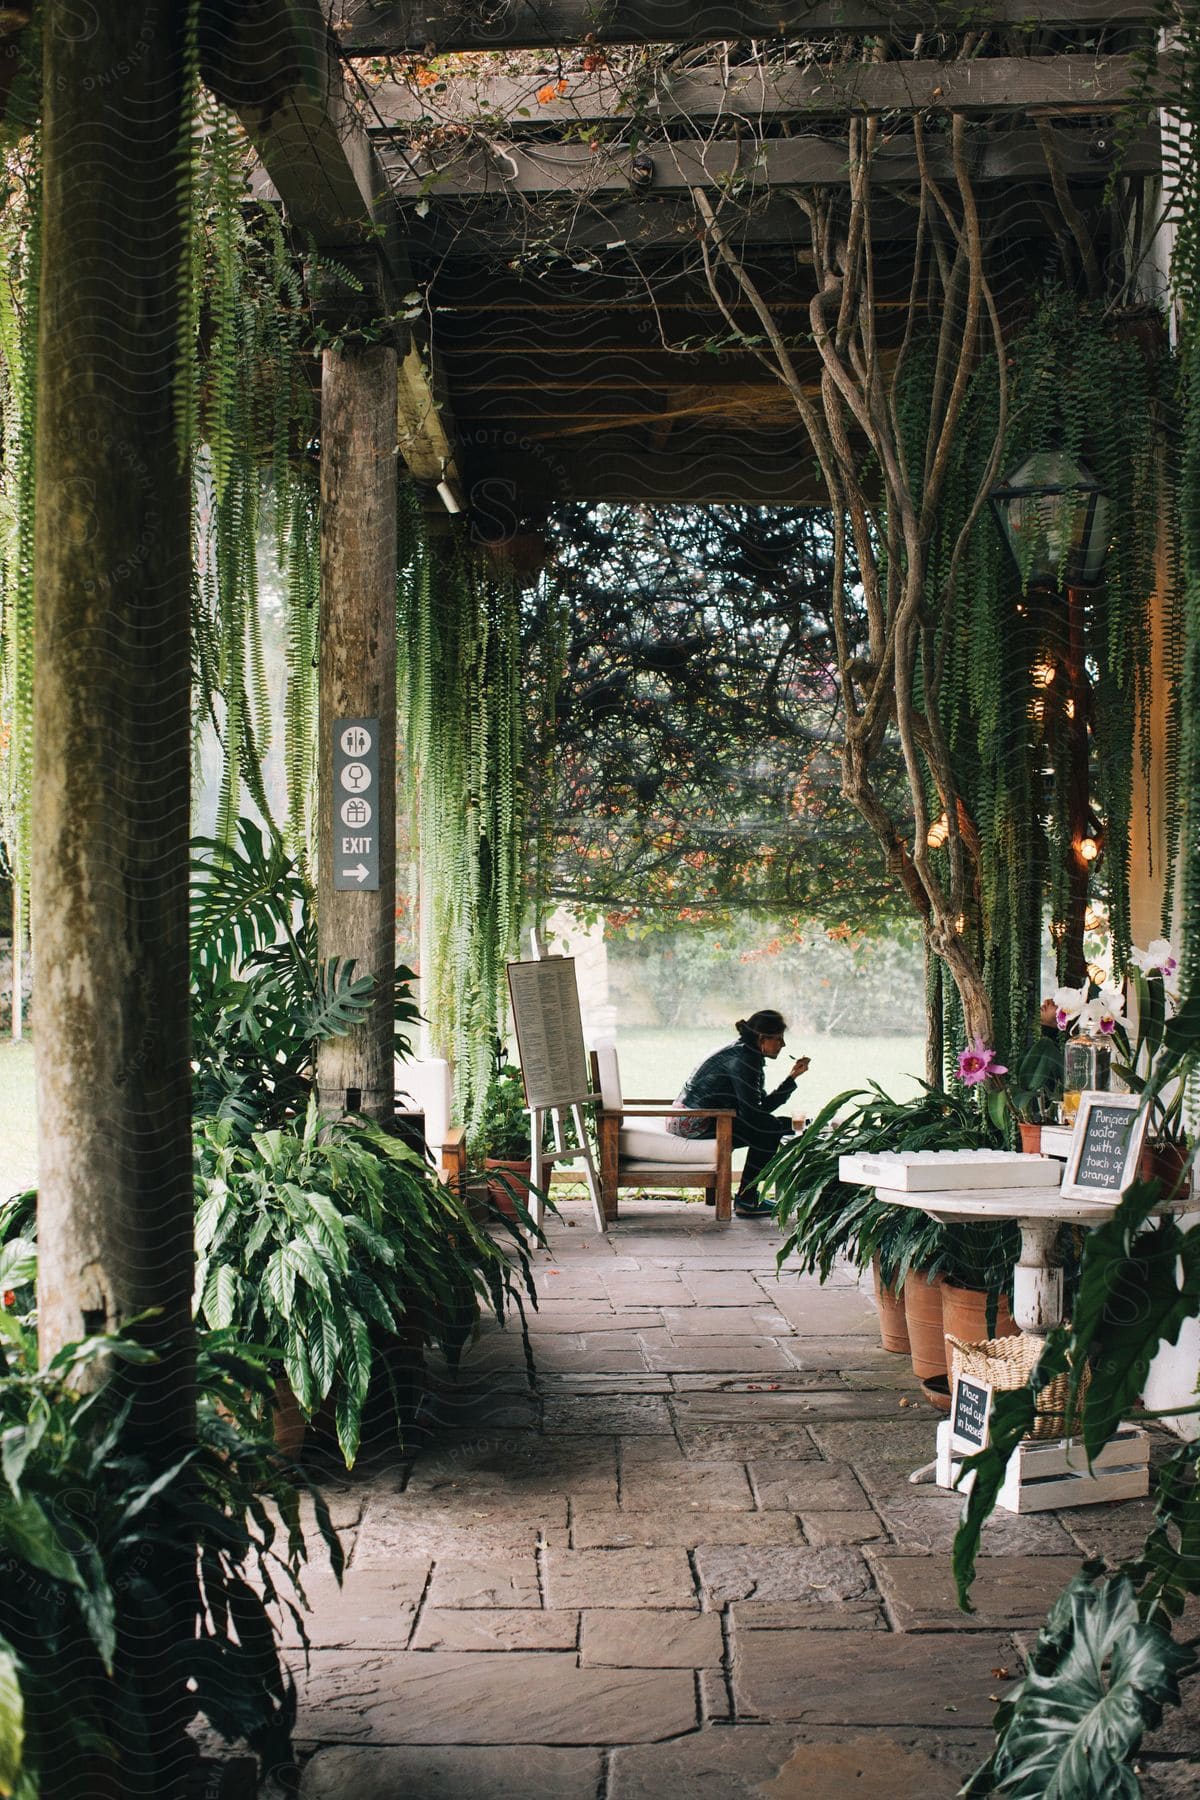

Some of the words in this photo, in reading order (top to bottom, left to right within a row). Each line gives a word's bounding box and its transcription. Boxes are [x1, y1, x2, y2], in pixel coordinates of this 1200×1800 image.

[342, 837, 372, 854] EXIT
[1089, 1126, 1118, 1138] water
[1090, 1140, 1112, 1154] with
[1114, 1146, 1122, 1156] a
[1086, 1155, 1110, 1169] touch
[1112, 1161, 1124, 1174] of
[1081, 1170, 1115, 1186] orange
[962, 1383, 979, 1404] Place
[959, 1403, 973, 1416] used
[957, 1415, 964, 1429] in
